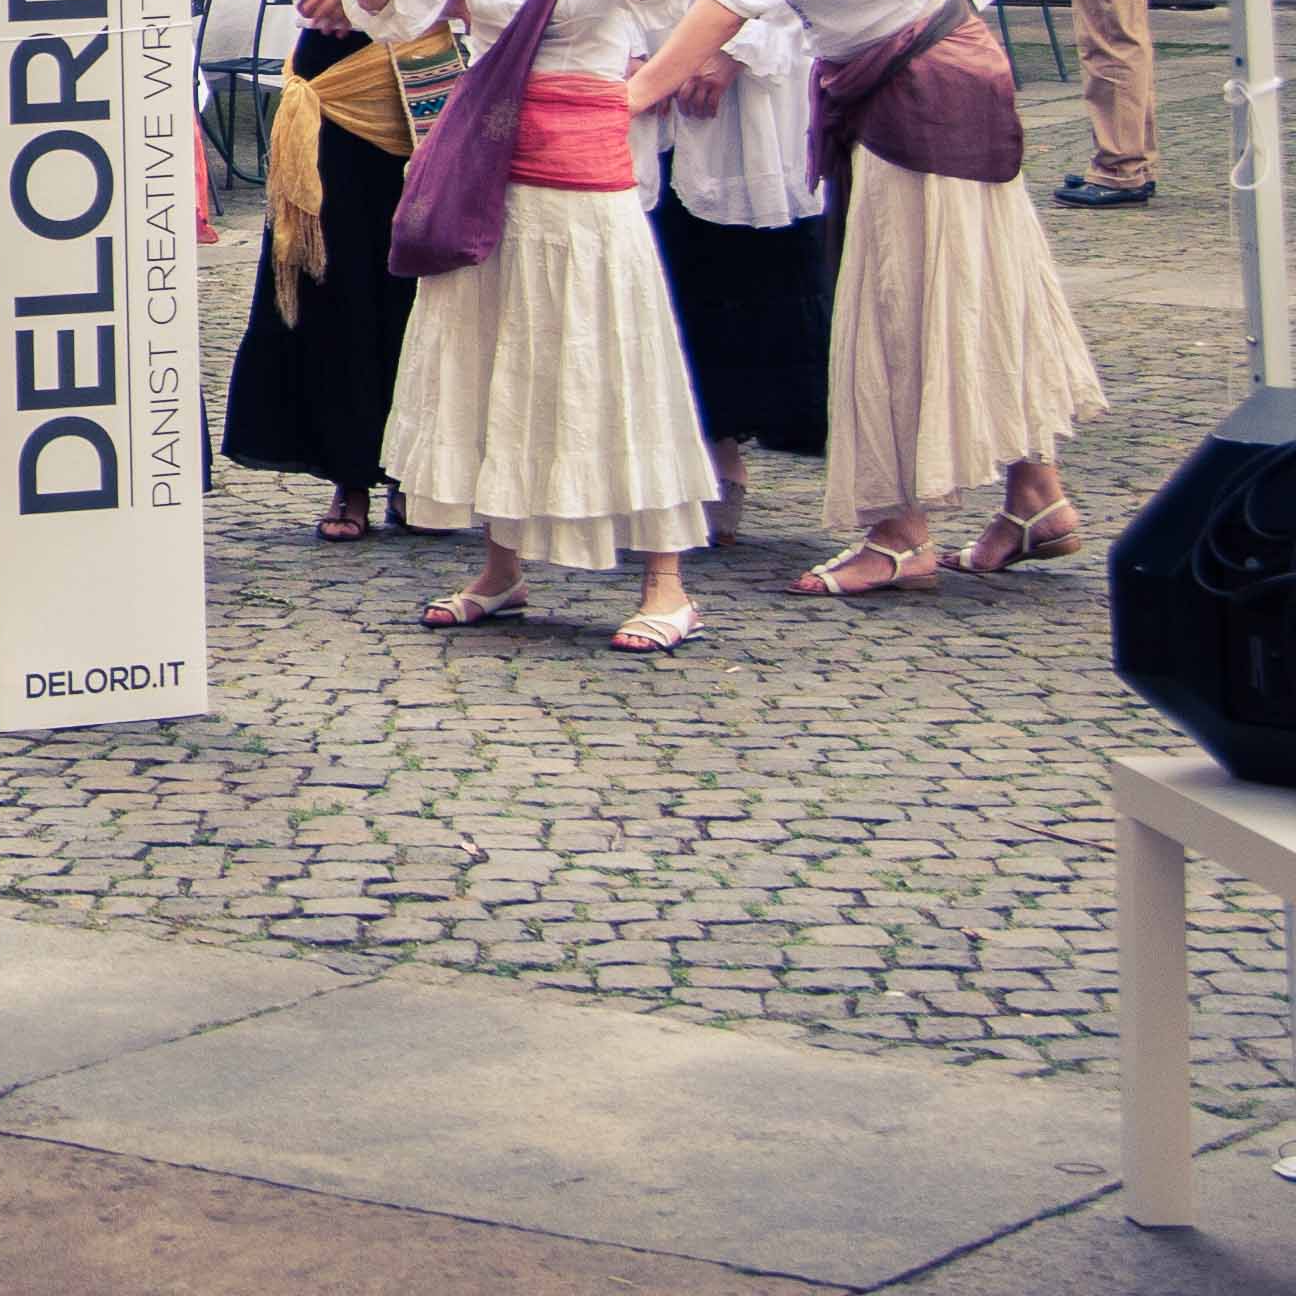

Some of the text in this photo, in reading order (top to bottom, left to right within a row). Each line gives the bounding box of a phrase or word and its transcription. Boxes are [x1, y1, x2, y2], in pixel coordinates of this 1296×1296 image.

[144, 113, 177, 325] CREATIVE
[149, 340, 182, 509] PIANIST
[25, 660, 185, 699] DELORD.IT
